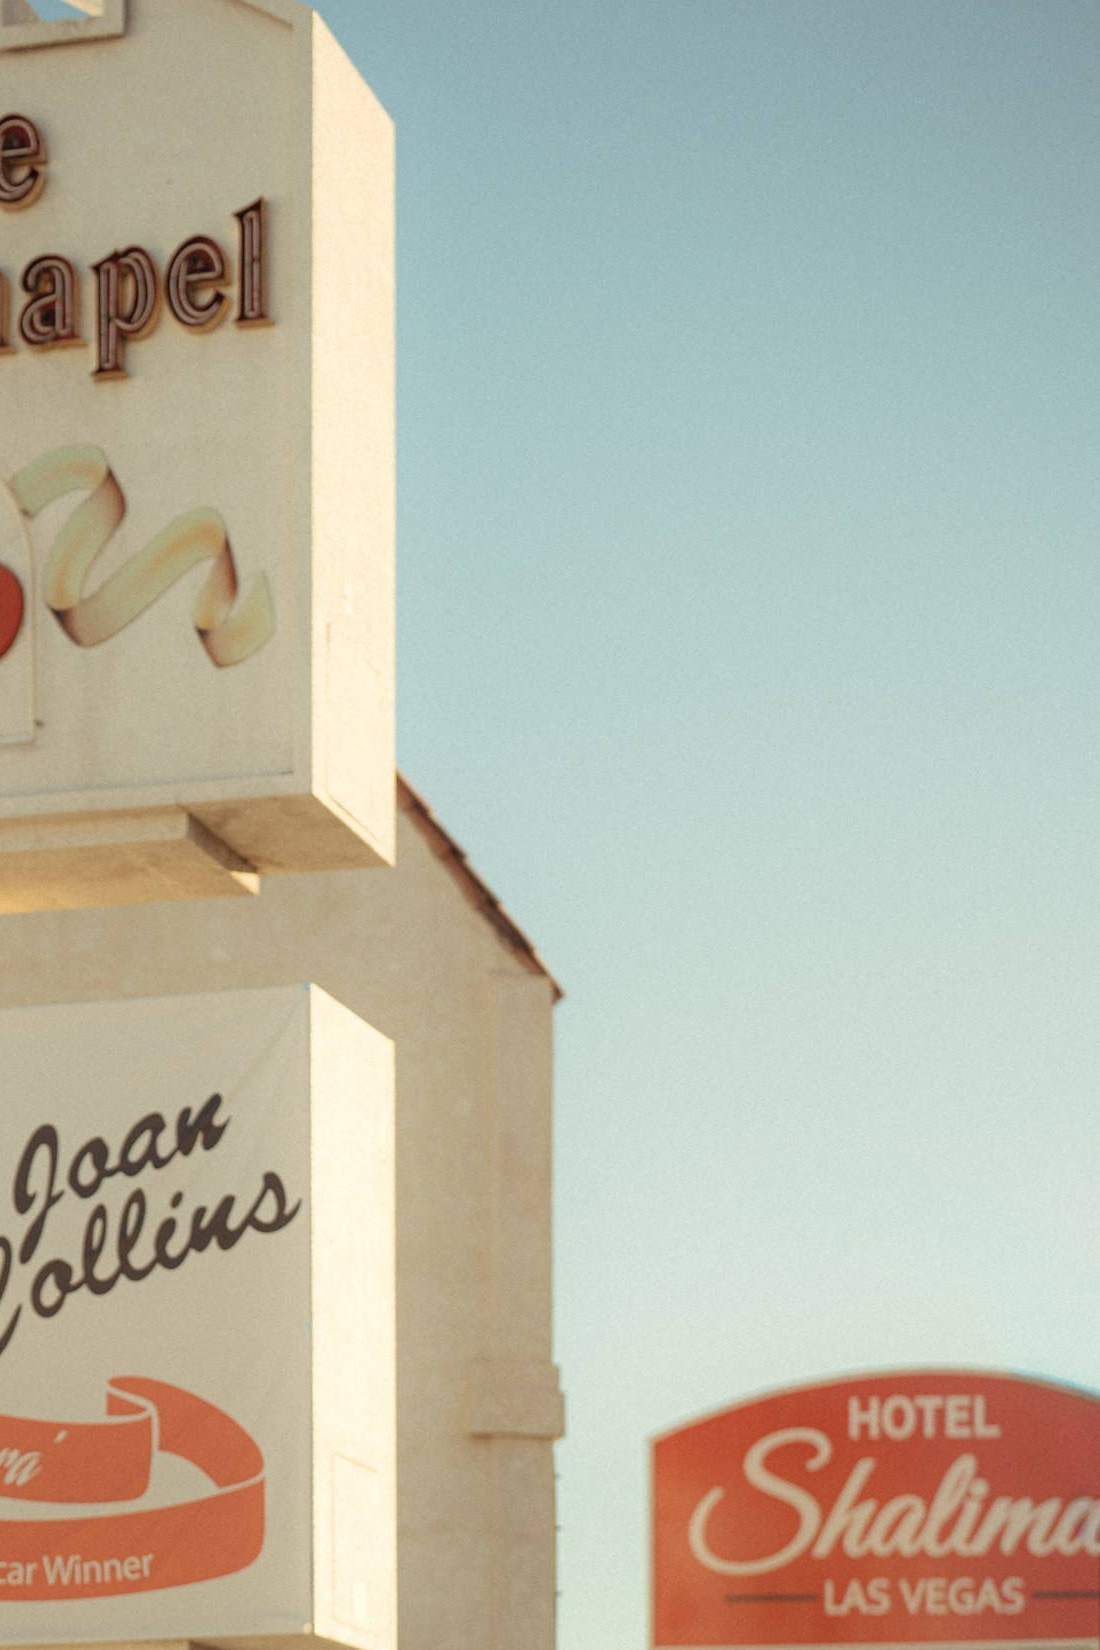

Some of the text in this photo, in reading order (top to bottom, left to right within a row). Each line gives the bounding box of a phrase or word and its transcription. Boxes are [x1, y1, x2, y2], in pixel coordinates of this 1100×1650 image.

[12, 1092, 232, 1264] Joan
[848, 1394, 1001, 1440] HOTEL
[688, 1426, 1100, 1576] Shalima
[43, 1552, 154, 1588] Winner
[824, 1576, 1025, 1616] LAS VEGAS
